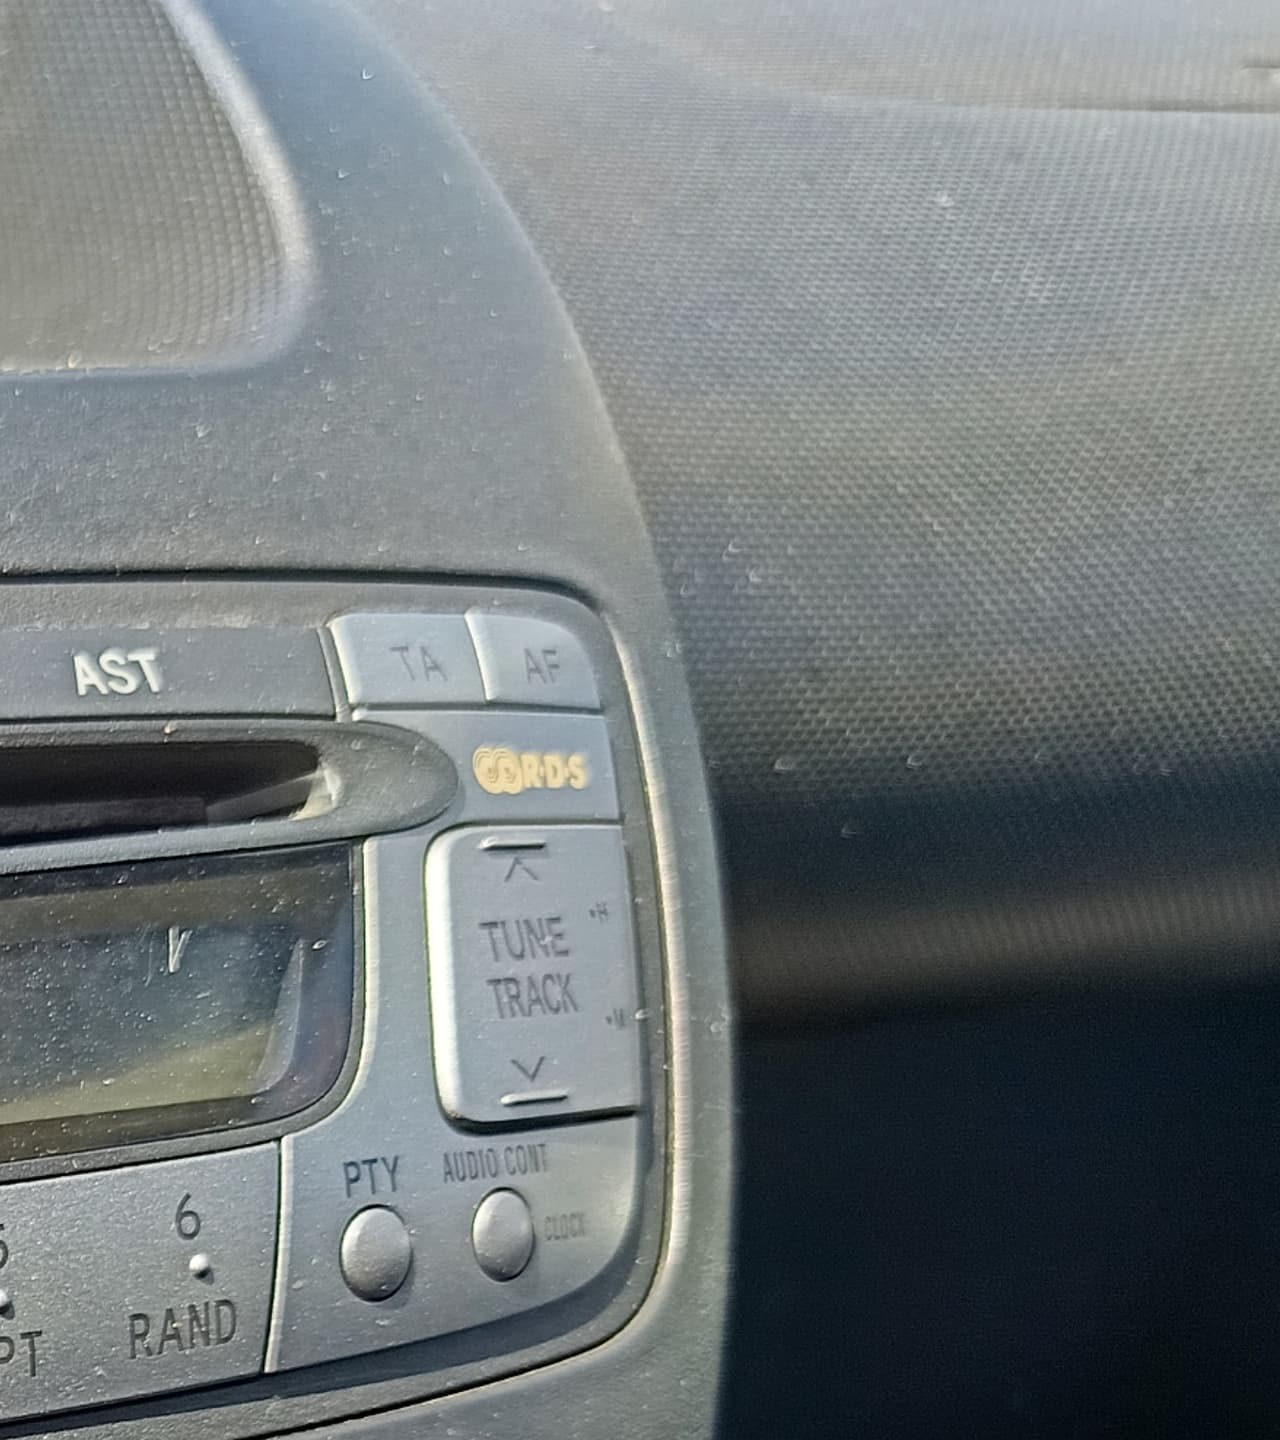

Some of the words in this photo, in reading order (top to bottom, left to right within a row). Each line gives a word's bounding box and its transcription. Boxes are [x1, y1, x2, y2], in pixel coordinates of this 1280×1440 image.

[73, 648, 164, 696] AST
[390, 646, 446, 682] TA
[524, 649, 560, 684] AF
[479, 916, 570, 963] TUNE
[487, 973, 578, 1019] TRACK
[343, 1155, 400, 1198] PTY
[443, 1148, 499, 1184] AUDIO
[503, 1143, 548, 1176] CONT
[175, 1193, 201, 1240] 6
[129, 1299, 237, 1359] RAND
